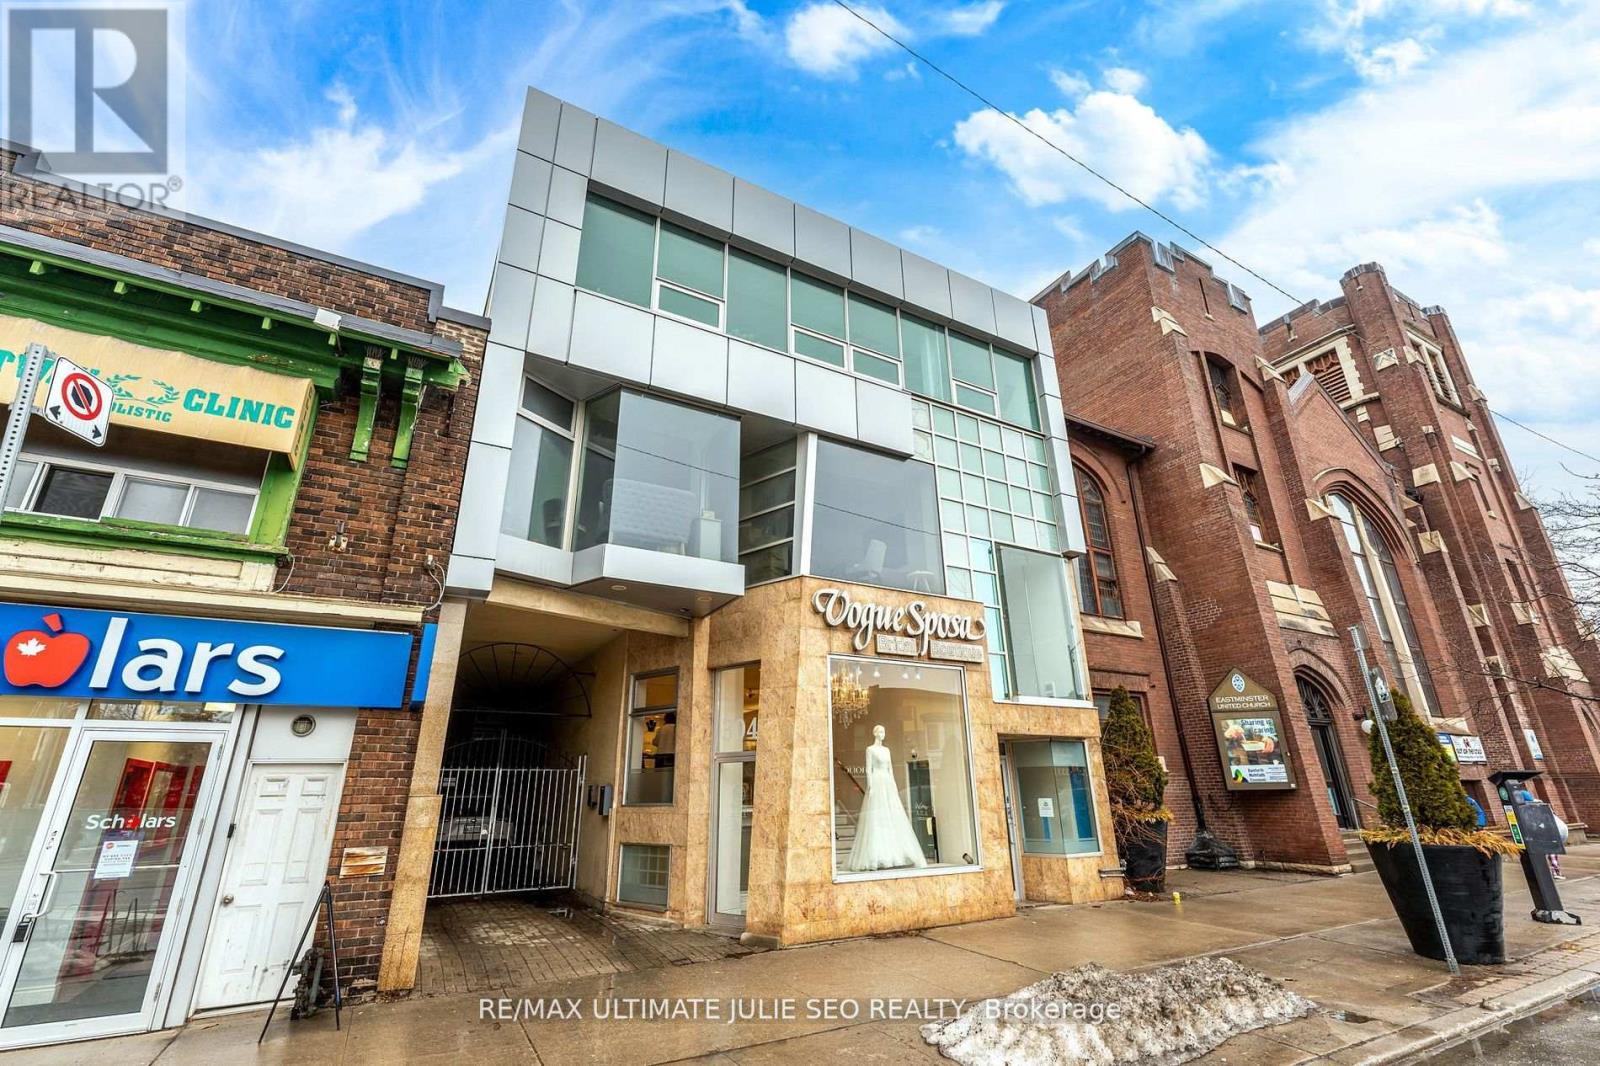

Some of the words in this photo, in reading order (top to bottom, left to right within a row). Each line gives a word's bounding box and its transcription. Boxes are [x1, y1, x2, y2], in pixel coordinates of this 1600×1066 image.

[183, 388, 295, 428] CLINIC
[812, 587, 904, 650] Vogue
[905, 601, 986, 656] Sposa
[1216, 695, 1269, 704] EASTMINSTER
